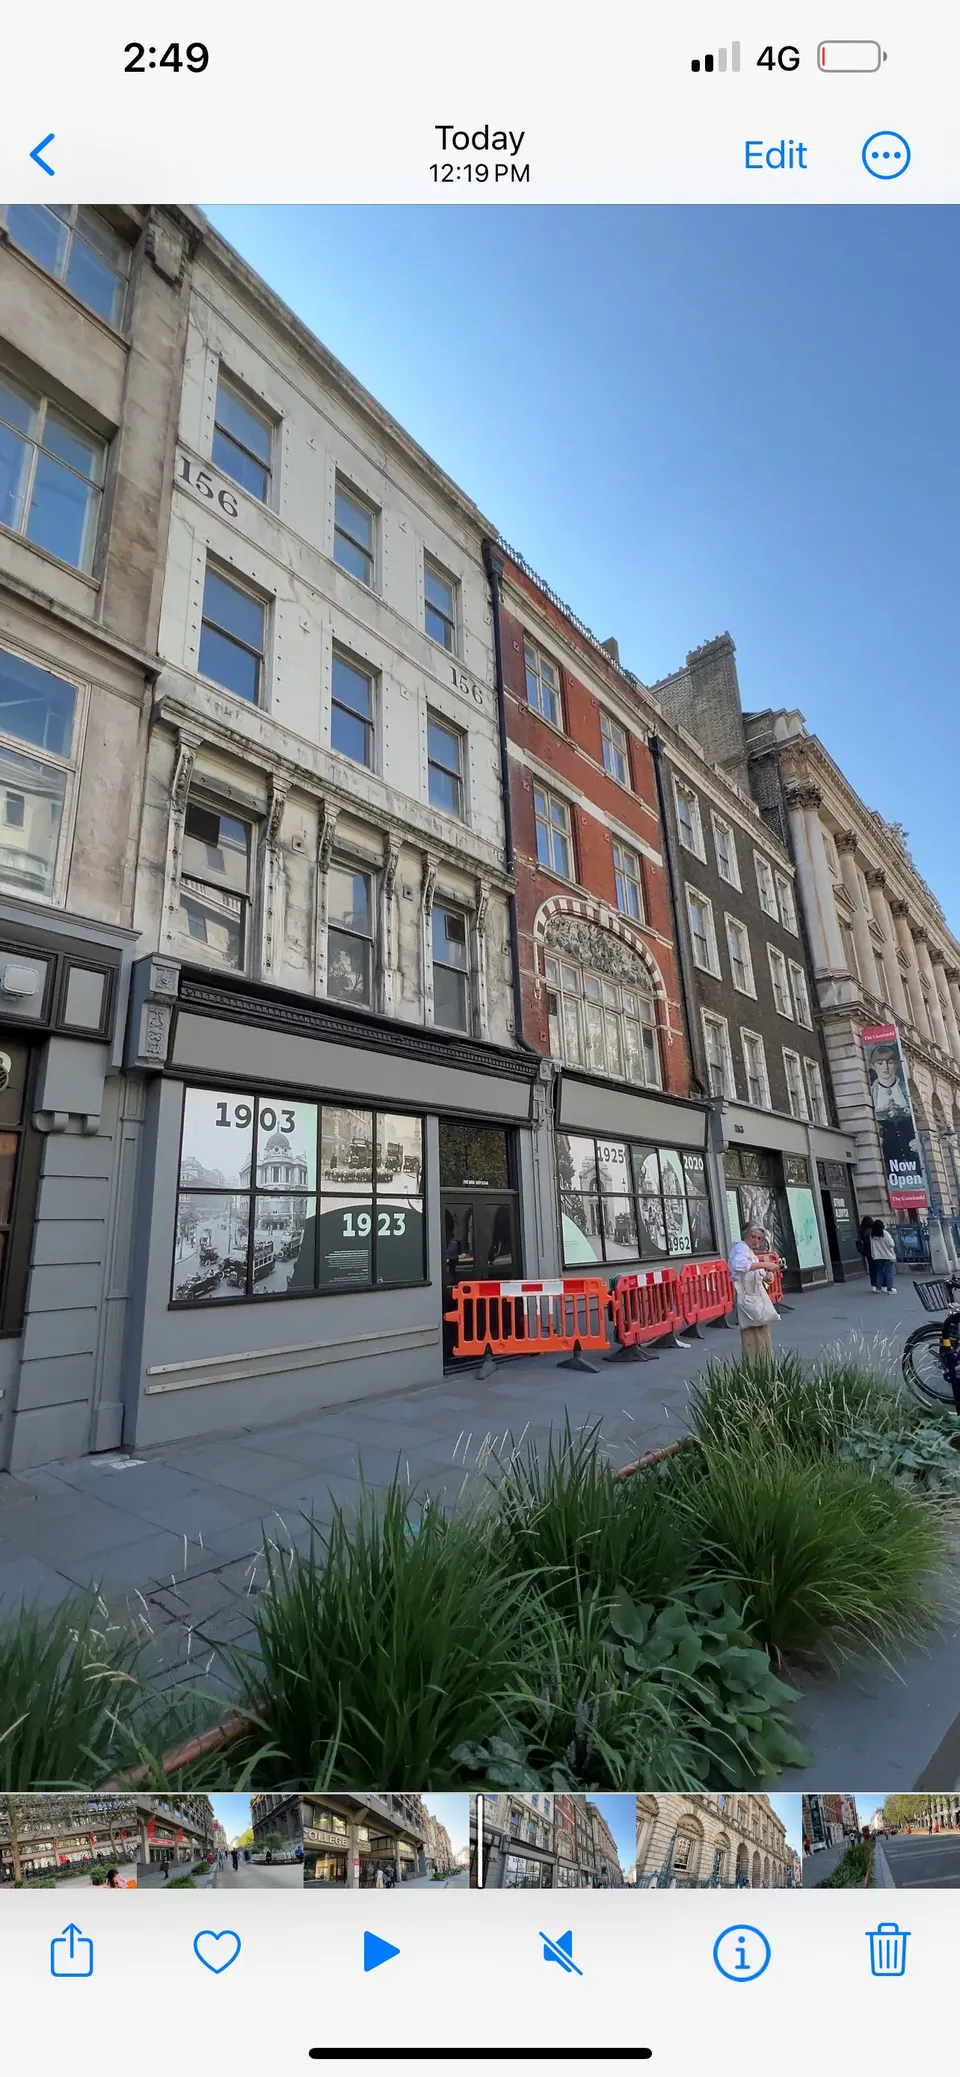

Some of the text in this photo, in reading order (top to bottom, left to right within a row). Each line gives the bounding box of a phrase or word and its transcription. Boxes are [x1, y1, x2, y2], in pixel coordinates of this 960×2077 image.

[177, 456, 240, 519] 156
[450, 666, 484, 705] 156
[215, 1102, 296, 1134] 1903
[597, 1146, 625, 1164] 1925
[683, 1155, 704, 1171] 2020
[889, 1159, 916, 1173] Now
[889, 1173, 922, 1188] Open
[342, 1212, 406, 1238] 1923
[668, 1236, 691, 1252] 1962
